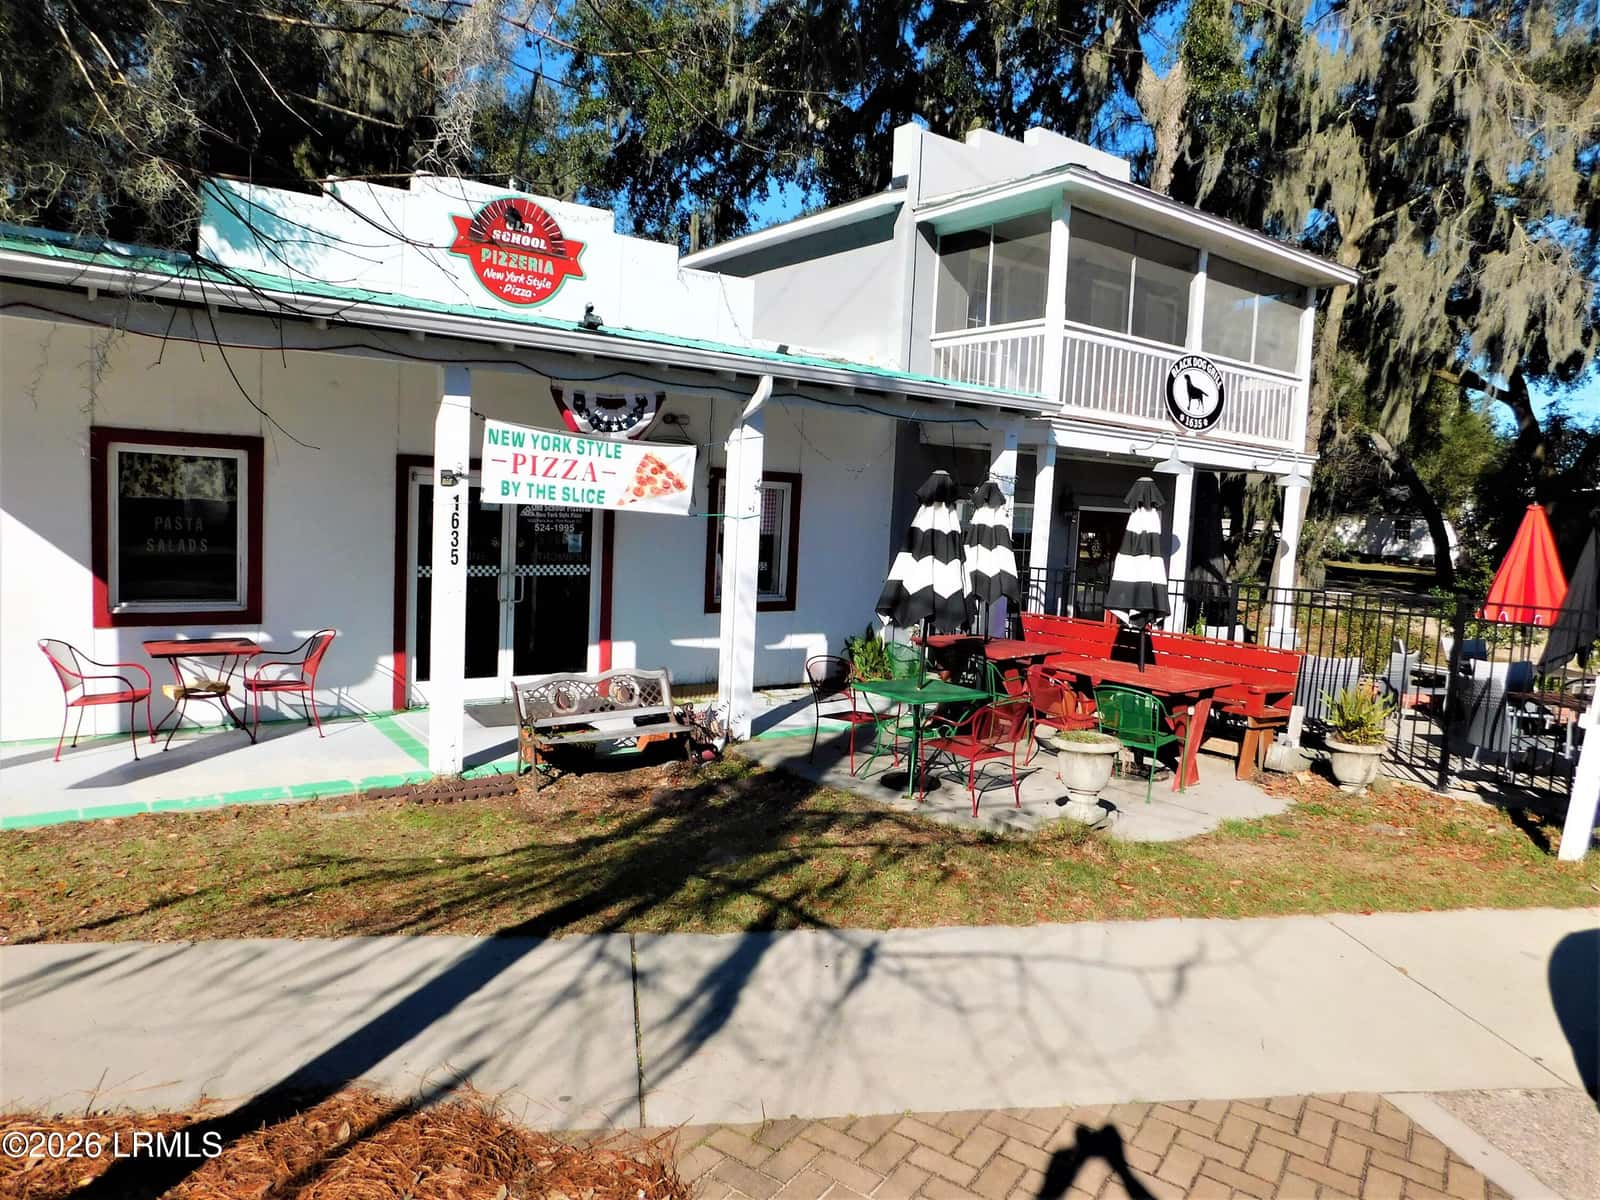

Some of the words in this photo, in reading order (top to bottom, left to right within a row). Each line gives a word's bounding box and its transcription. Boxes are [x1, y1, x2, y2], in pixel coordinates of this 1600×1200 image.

[492, 229, 547, 250] SCHOOL
[481, 247, 555, 275] PIZZERIA
[483, 267, 505, 280] New
[505, 270, 526, 285] York
[525, 274, 552, 290] Style
[1171, 357, 1193, 378] BLACK
[1193, 357, 1208, 370] DOG
[488, 428, 526, 448] NEW
[531, 434, 572, 454] YORK
[576, 439, 622, 460] STYLE
[501, 480, 521, 497] BY
[526, 482, 557, 499] THE
[561, 486, 606, 505] SLICE
[153, 515, 204, 532] PASTA
[450, 494, 460, 566] 1635
[534, 523, 576, 532] 524-1995
[146, 537, 208, 553] SALADS
